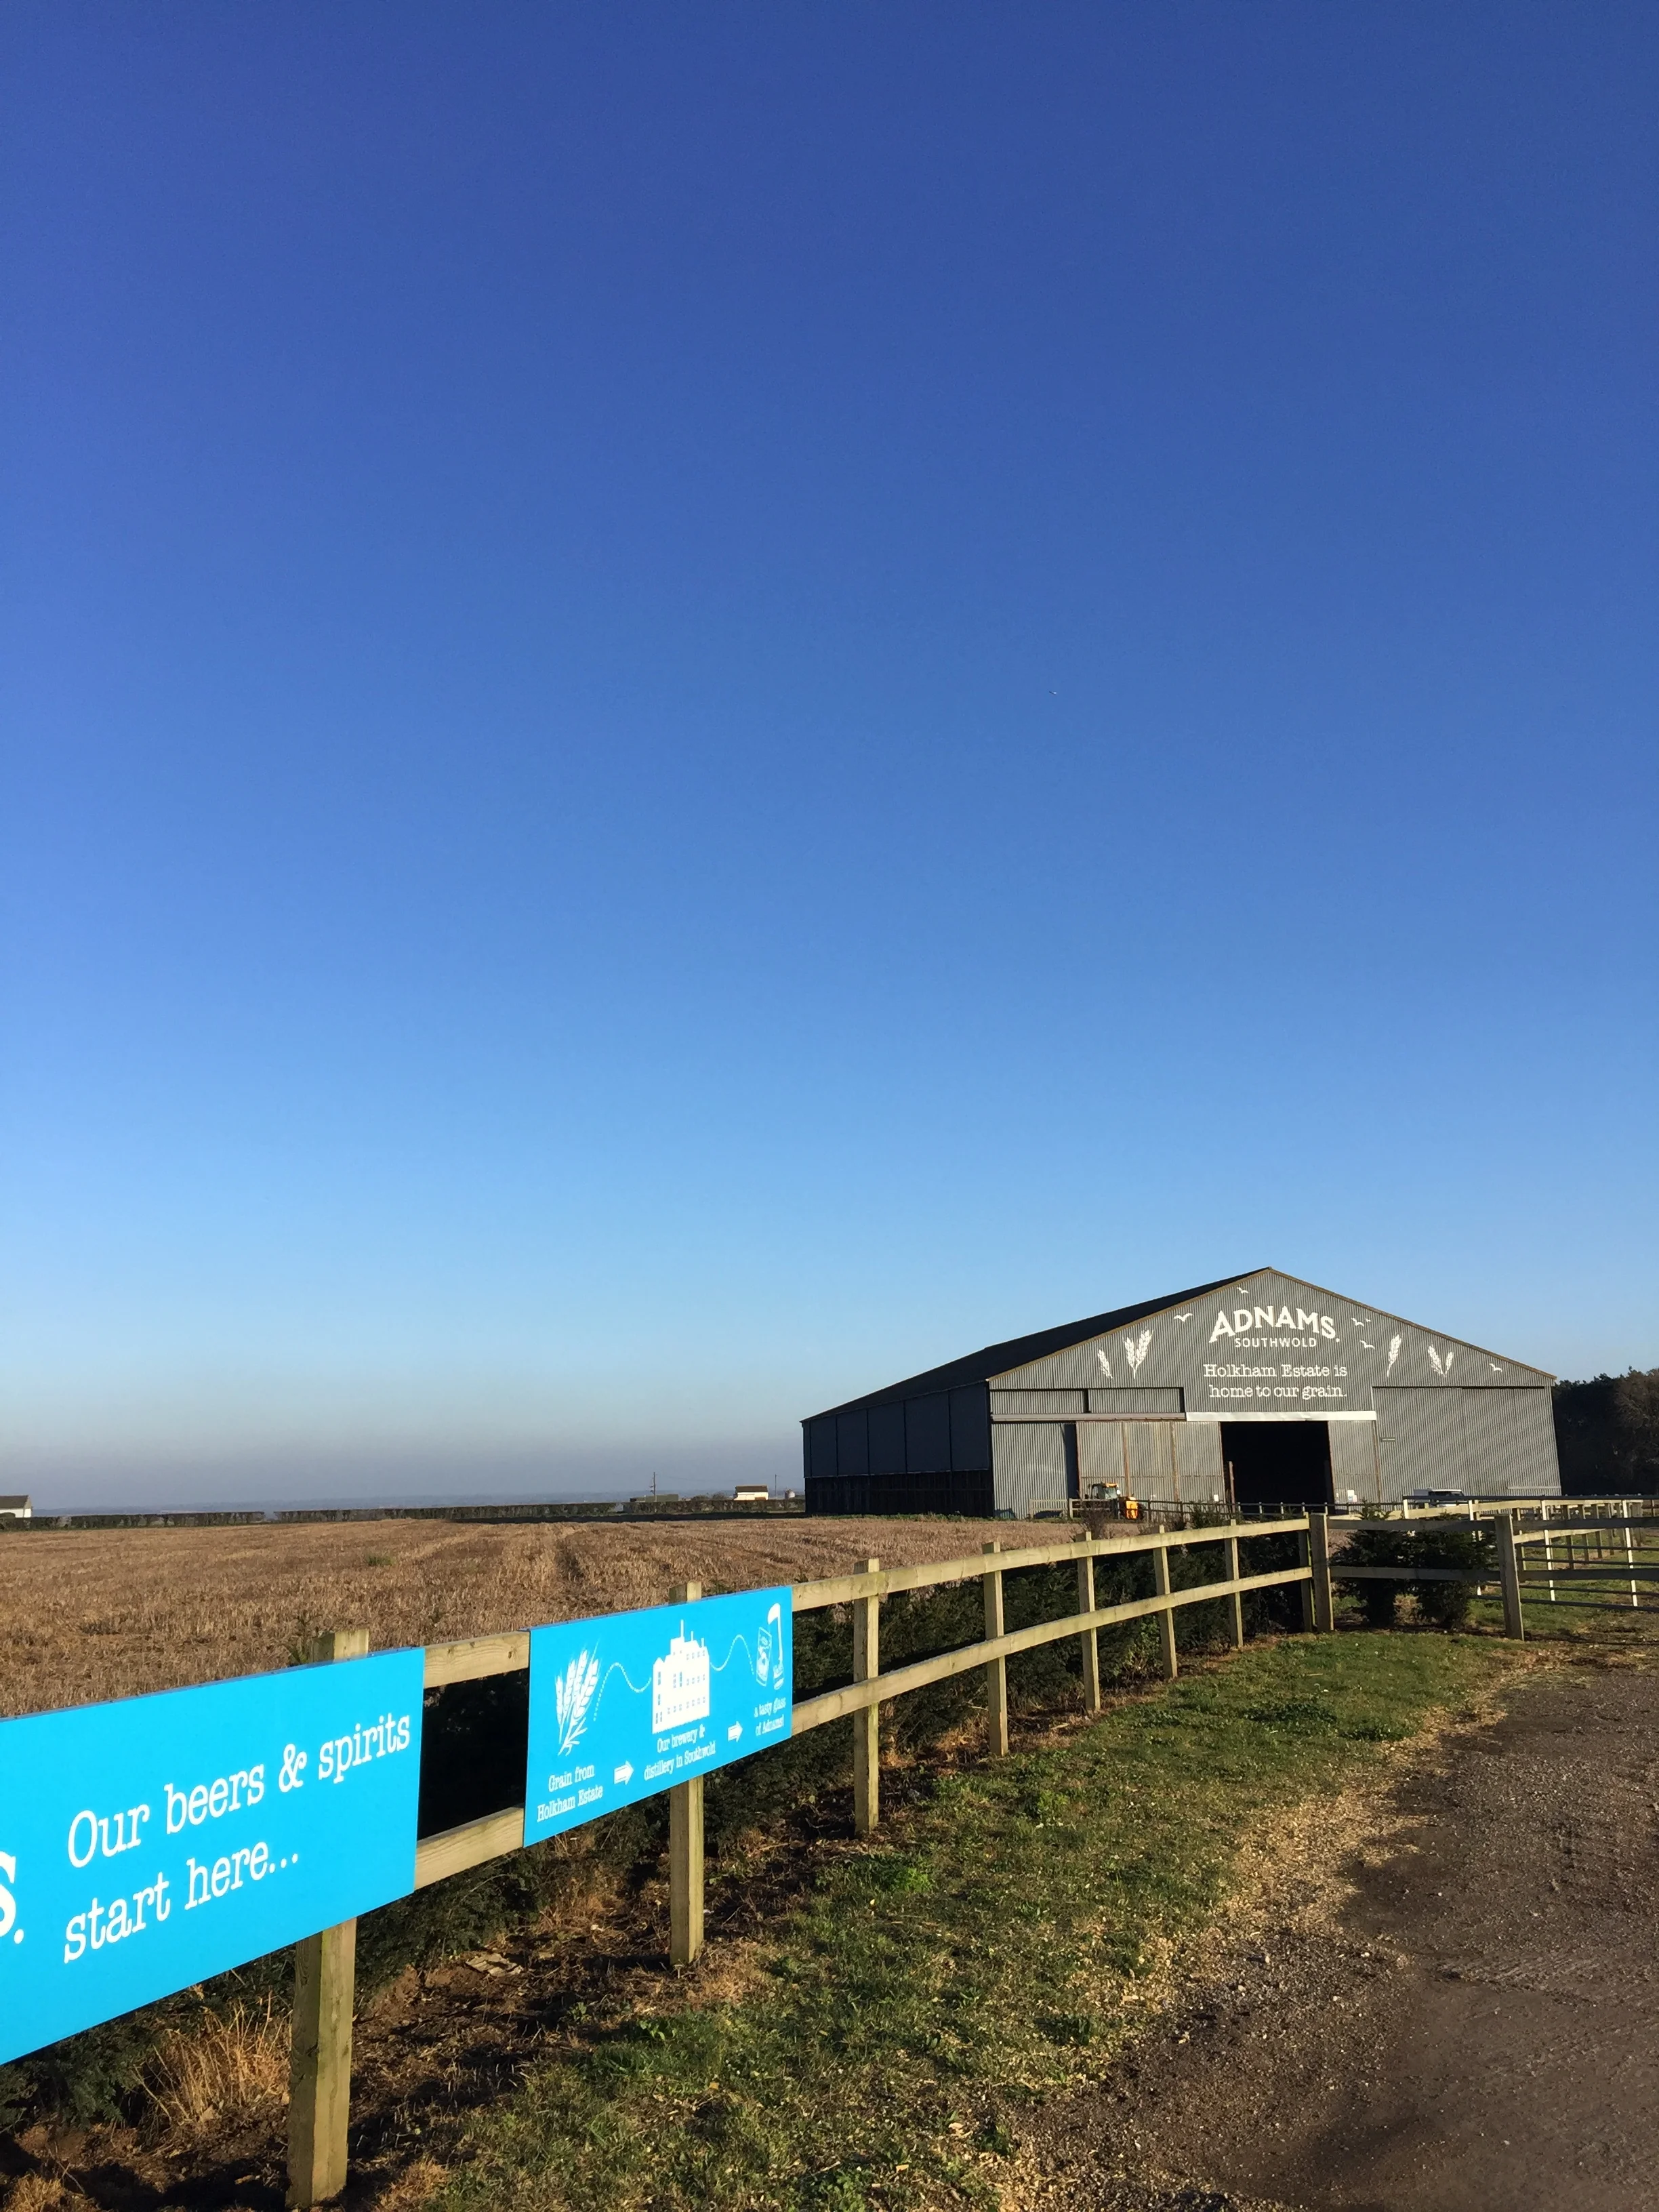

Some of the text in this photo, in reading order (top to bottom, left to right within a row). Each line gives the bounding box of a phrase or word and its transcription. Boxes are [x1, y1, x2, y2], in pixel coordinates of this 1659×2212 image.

[1234, 1337, 1317, 1347] SOUTHWOLD
[1203, 1364, 1347, 1377] Holkham Estate is
[1209, 1385, 1347, 1400] home to our grain.
[759, 1702, 773, 1716] tasty
[773, 1697, 786, 1714] glass
[657, 1723, 705, 1753] Our brewery &
[755, 1721, 762, 1736] of
[644, 1740, 716, 1781] distillery in Southwold
[68, 1713, 410, 1868] Our beers & spirits
[548, 1764, 595, 1793] Grain from
[536, 1784, 603, 1822] Holkham Estate
[63, 1841, 299, 1964] start here...
